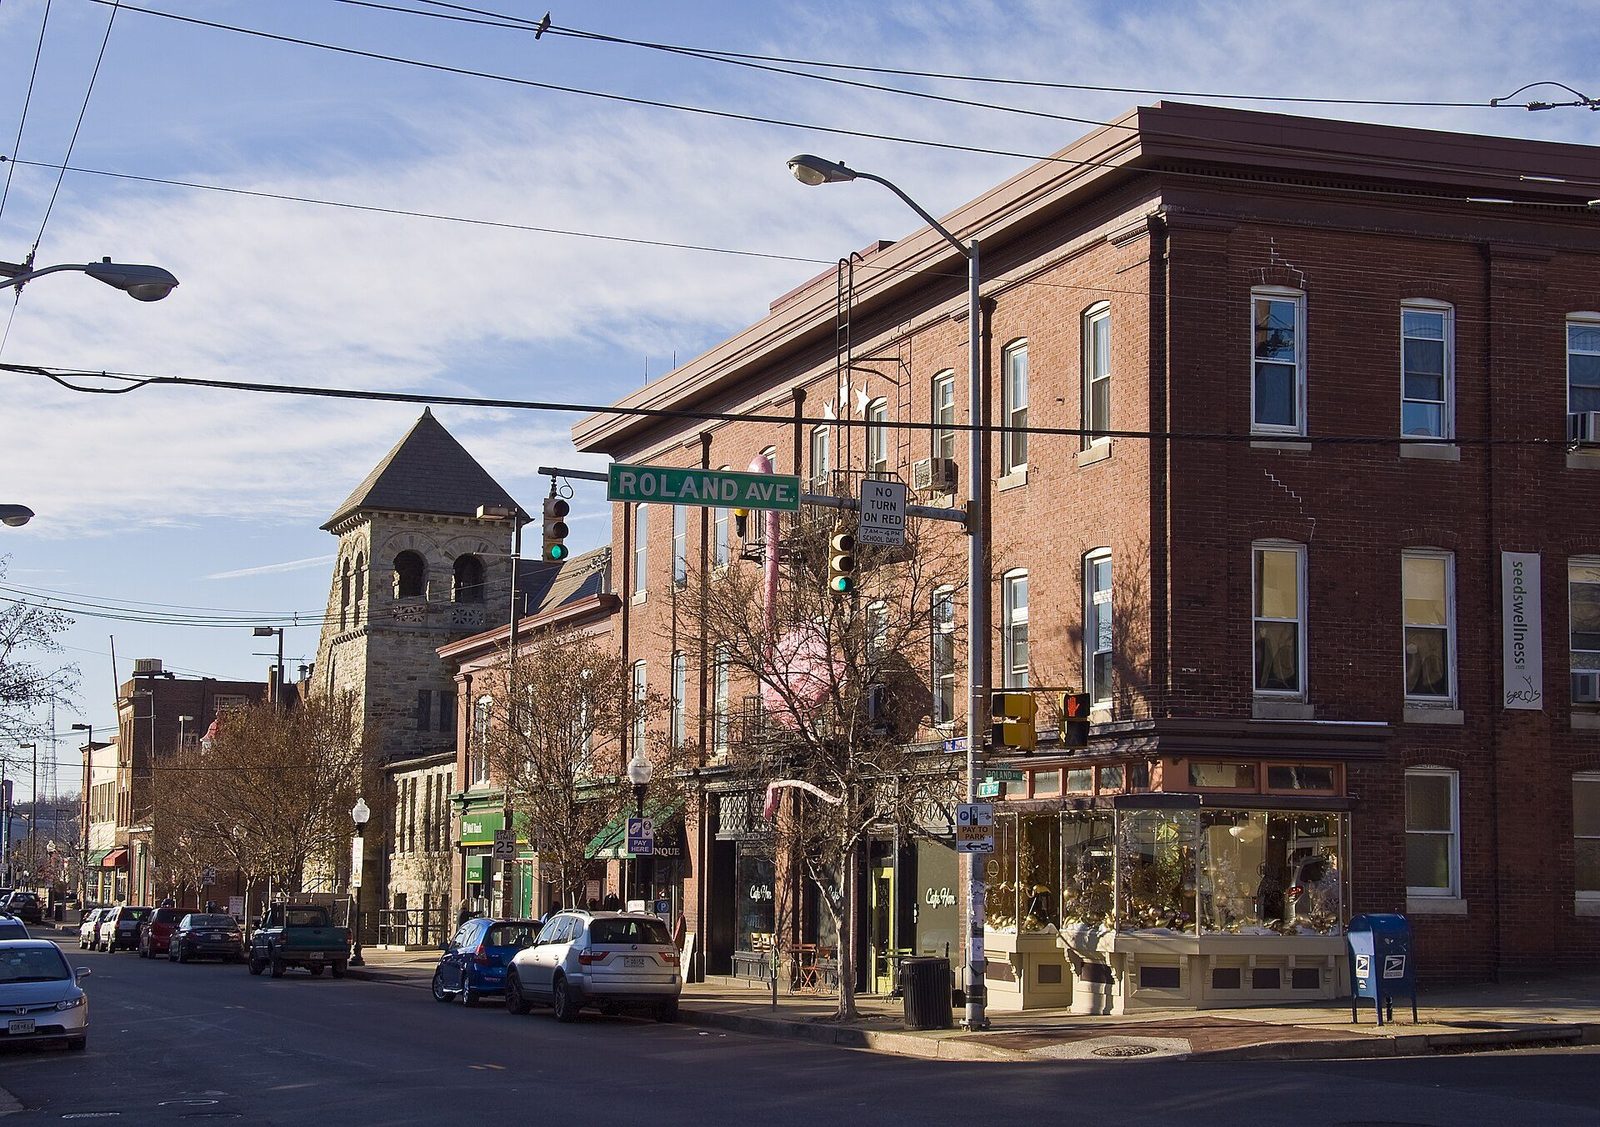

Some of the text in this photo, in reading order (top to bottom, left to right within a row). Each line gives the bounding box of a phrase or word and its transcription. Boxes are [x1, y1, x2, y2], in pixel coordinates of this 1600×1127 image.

[619, 471, 794, 503] ROLAND AVE.
[875, 487, 893, 497] NO
[870, 499, 897, 511] TURN
[864, 512, 902, 525] ON RED
[862, 535, 885, 543] SCHOOL
[1512, 561, 1528, 664] seedswellness
[1506, 676, 1541, 705] seeds
[496, 841, 514, 853] 25
[654, 847, 680, 857] NQUE
